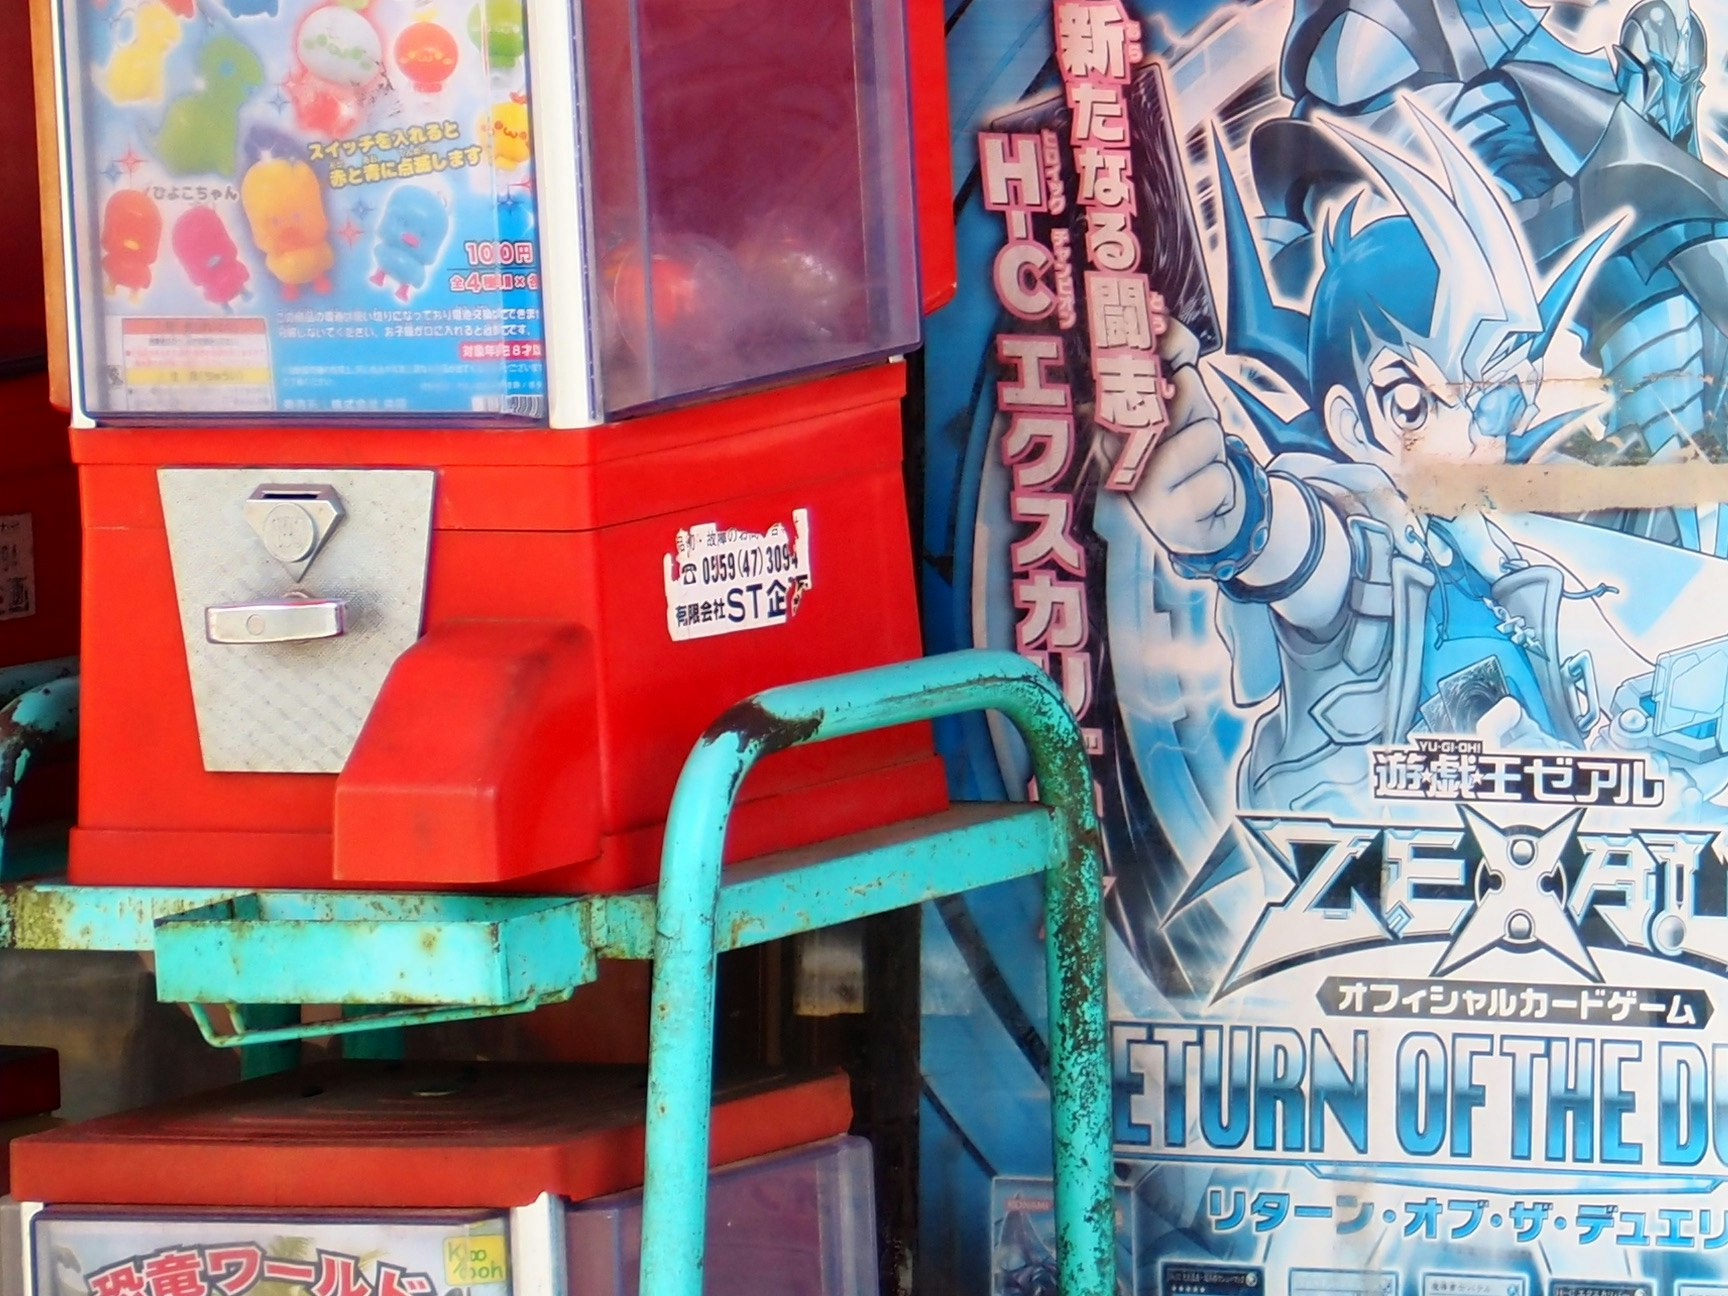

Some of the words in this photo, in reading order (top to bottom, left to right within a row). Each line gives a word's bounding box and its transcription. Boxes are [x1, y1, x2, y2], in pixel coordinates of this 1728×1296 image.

[308, 121, 461, 162] スイッチを入れると
[464, 241, 534, 265] 100円
[998, 335, 1104, 818] エクスカリ
[1337, 981, 1697, 1026] オフィシャルカードゲーム
[1113, 1021, 1373, 1158] ETURN
[1398, 1026, 1496, 1164] OF
[1500, 1031, 1646, 1165] THE
